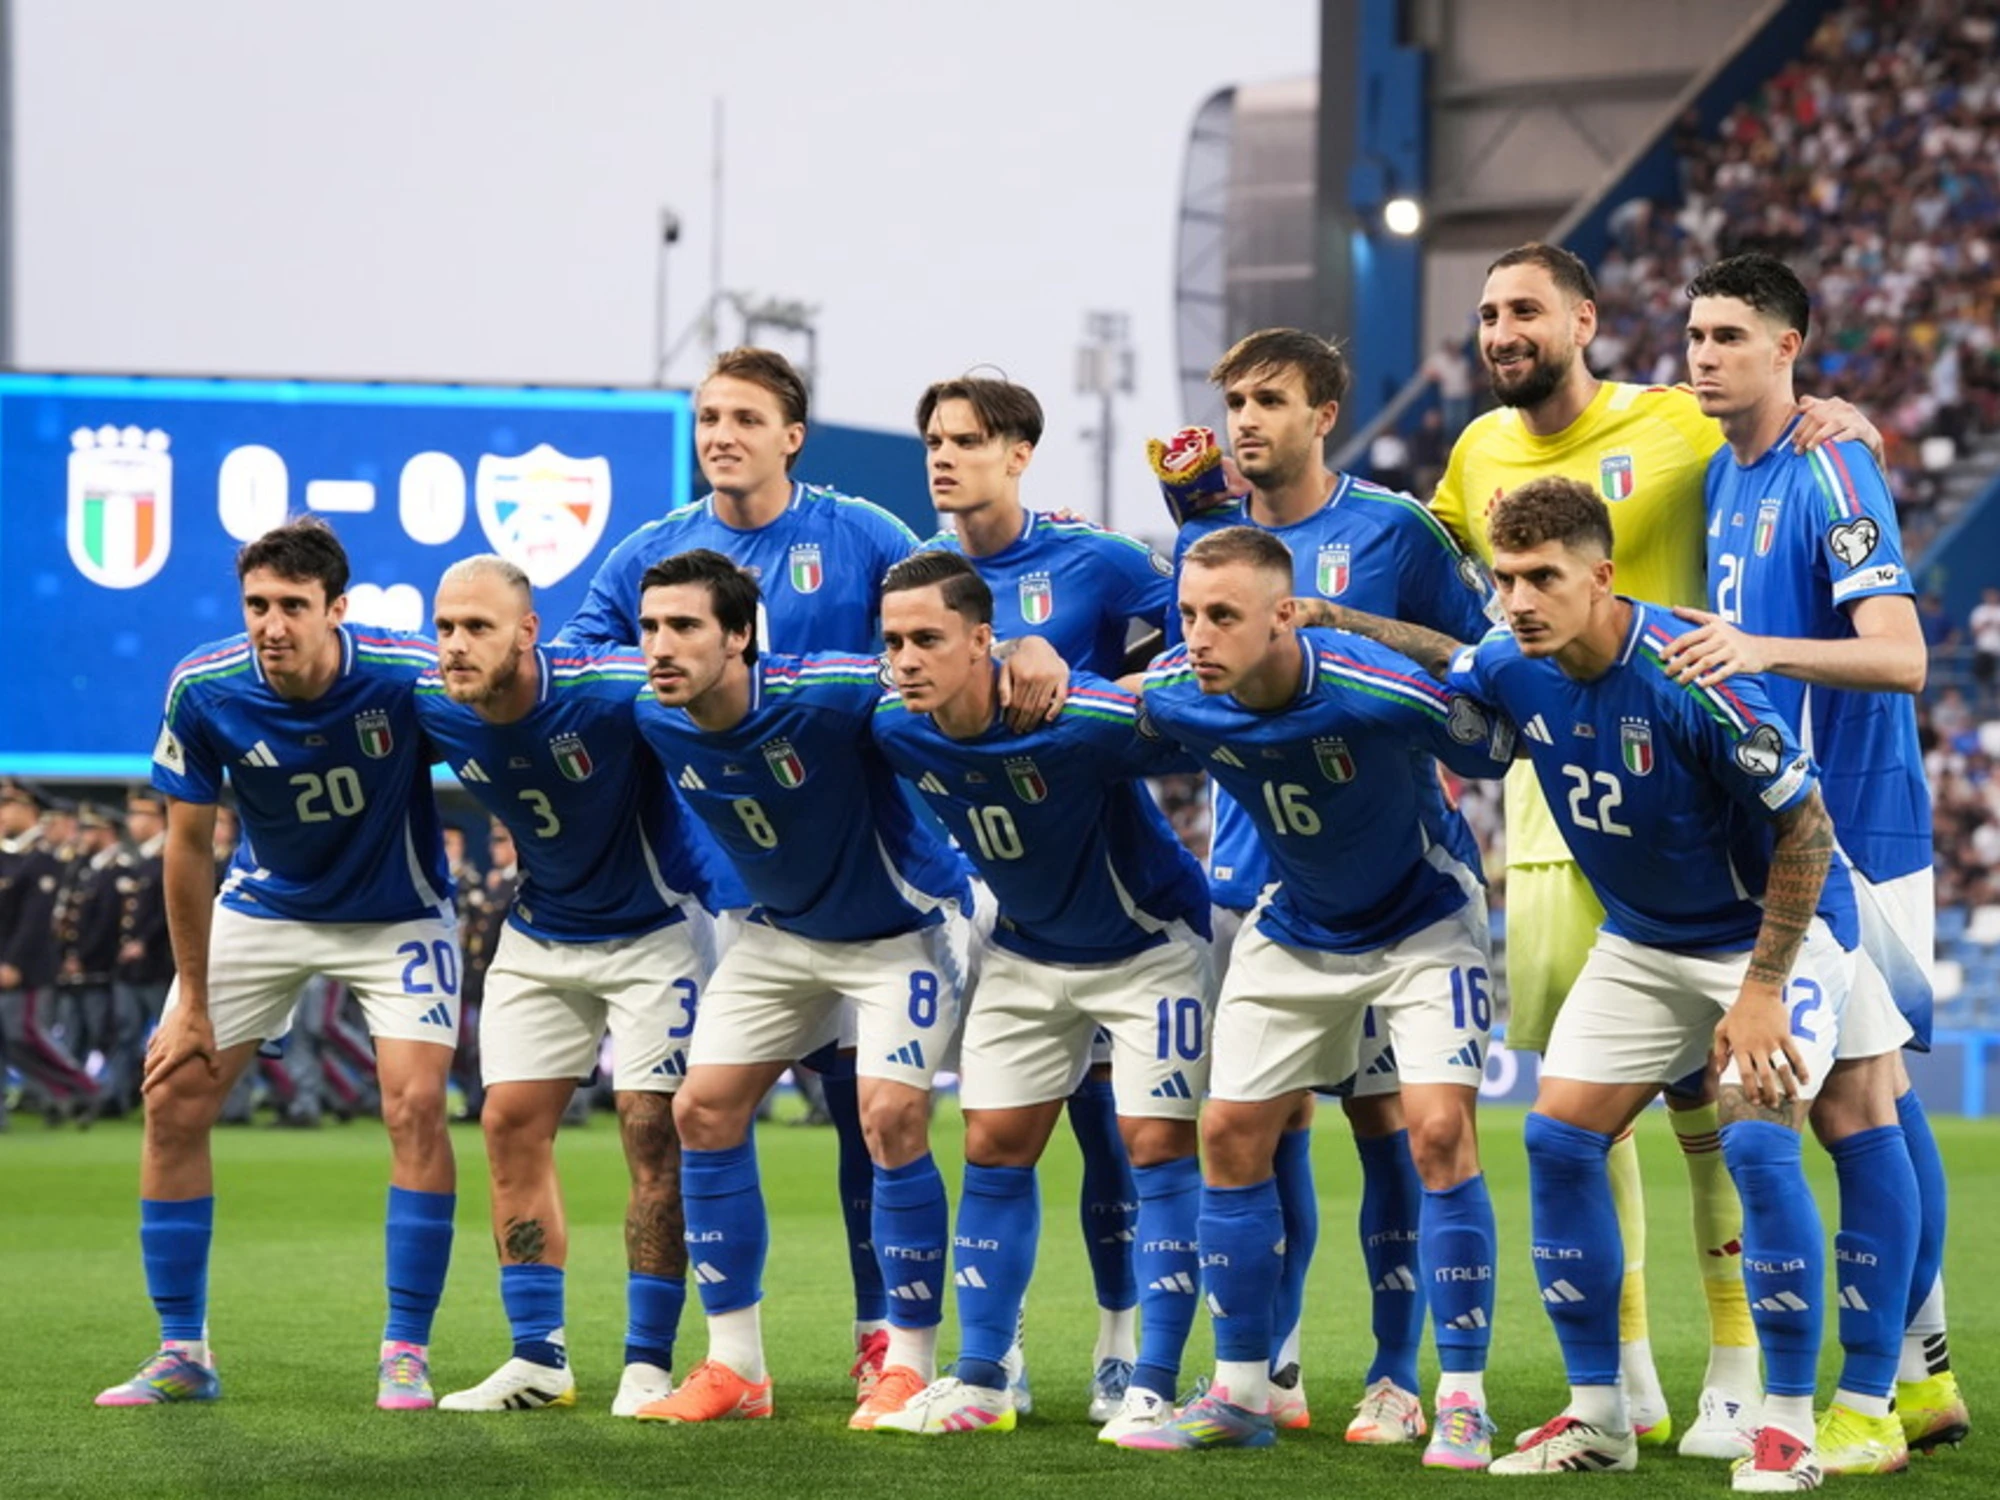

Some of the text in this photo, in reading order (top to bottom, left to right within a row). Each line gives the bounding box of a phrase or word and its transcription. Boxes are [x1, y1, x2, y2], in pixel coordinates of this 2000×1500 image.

[1717, 553, 1745, 625] 21
[289, 766, 365, 823] 20
[518, 789, 560, 838] 3
[732, 797, 778, 849] 8
[1262, 780, 1322, 835] 16
[1562, 764, 1633, 837] 22
[967, 806, 1025, 860] 10
[397, 939, 458, 996] 20
[668, 978, 698, 1038] 3
[908, 970, 939, 1028] 8
[1450, 965, 1492, 1032] 16
[1782, 977, 1822, 1043] 2
[1157, 997, 1203, 1060] 10
[1435, 1265, 1493, 1283] ITALIA
